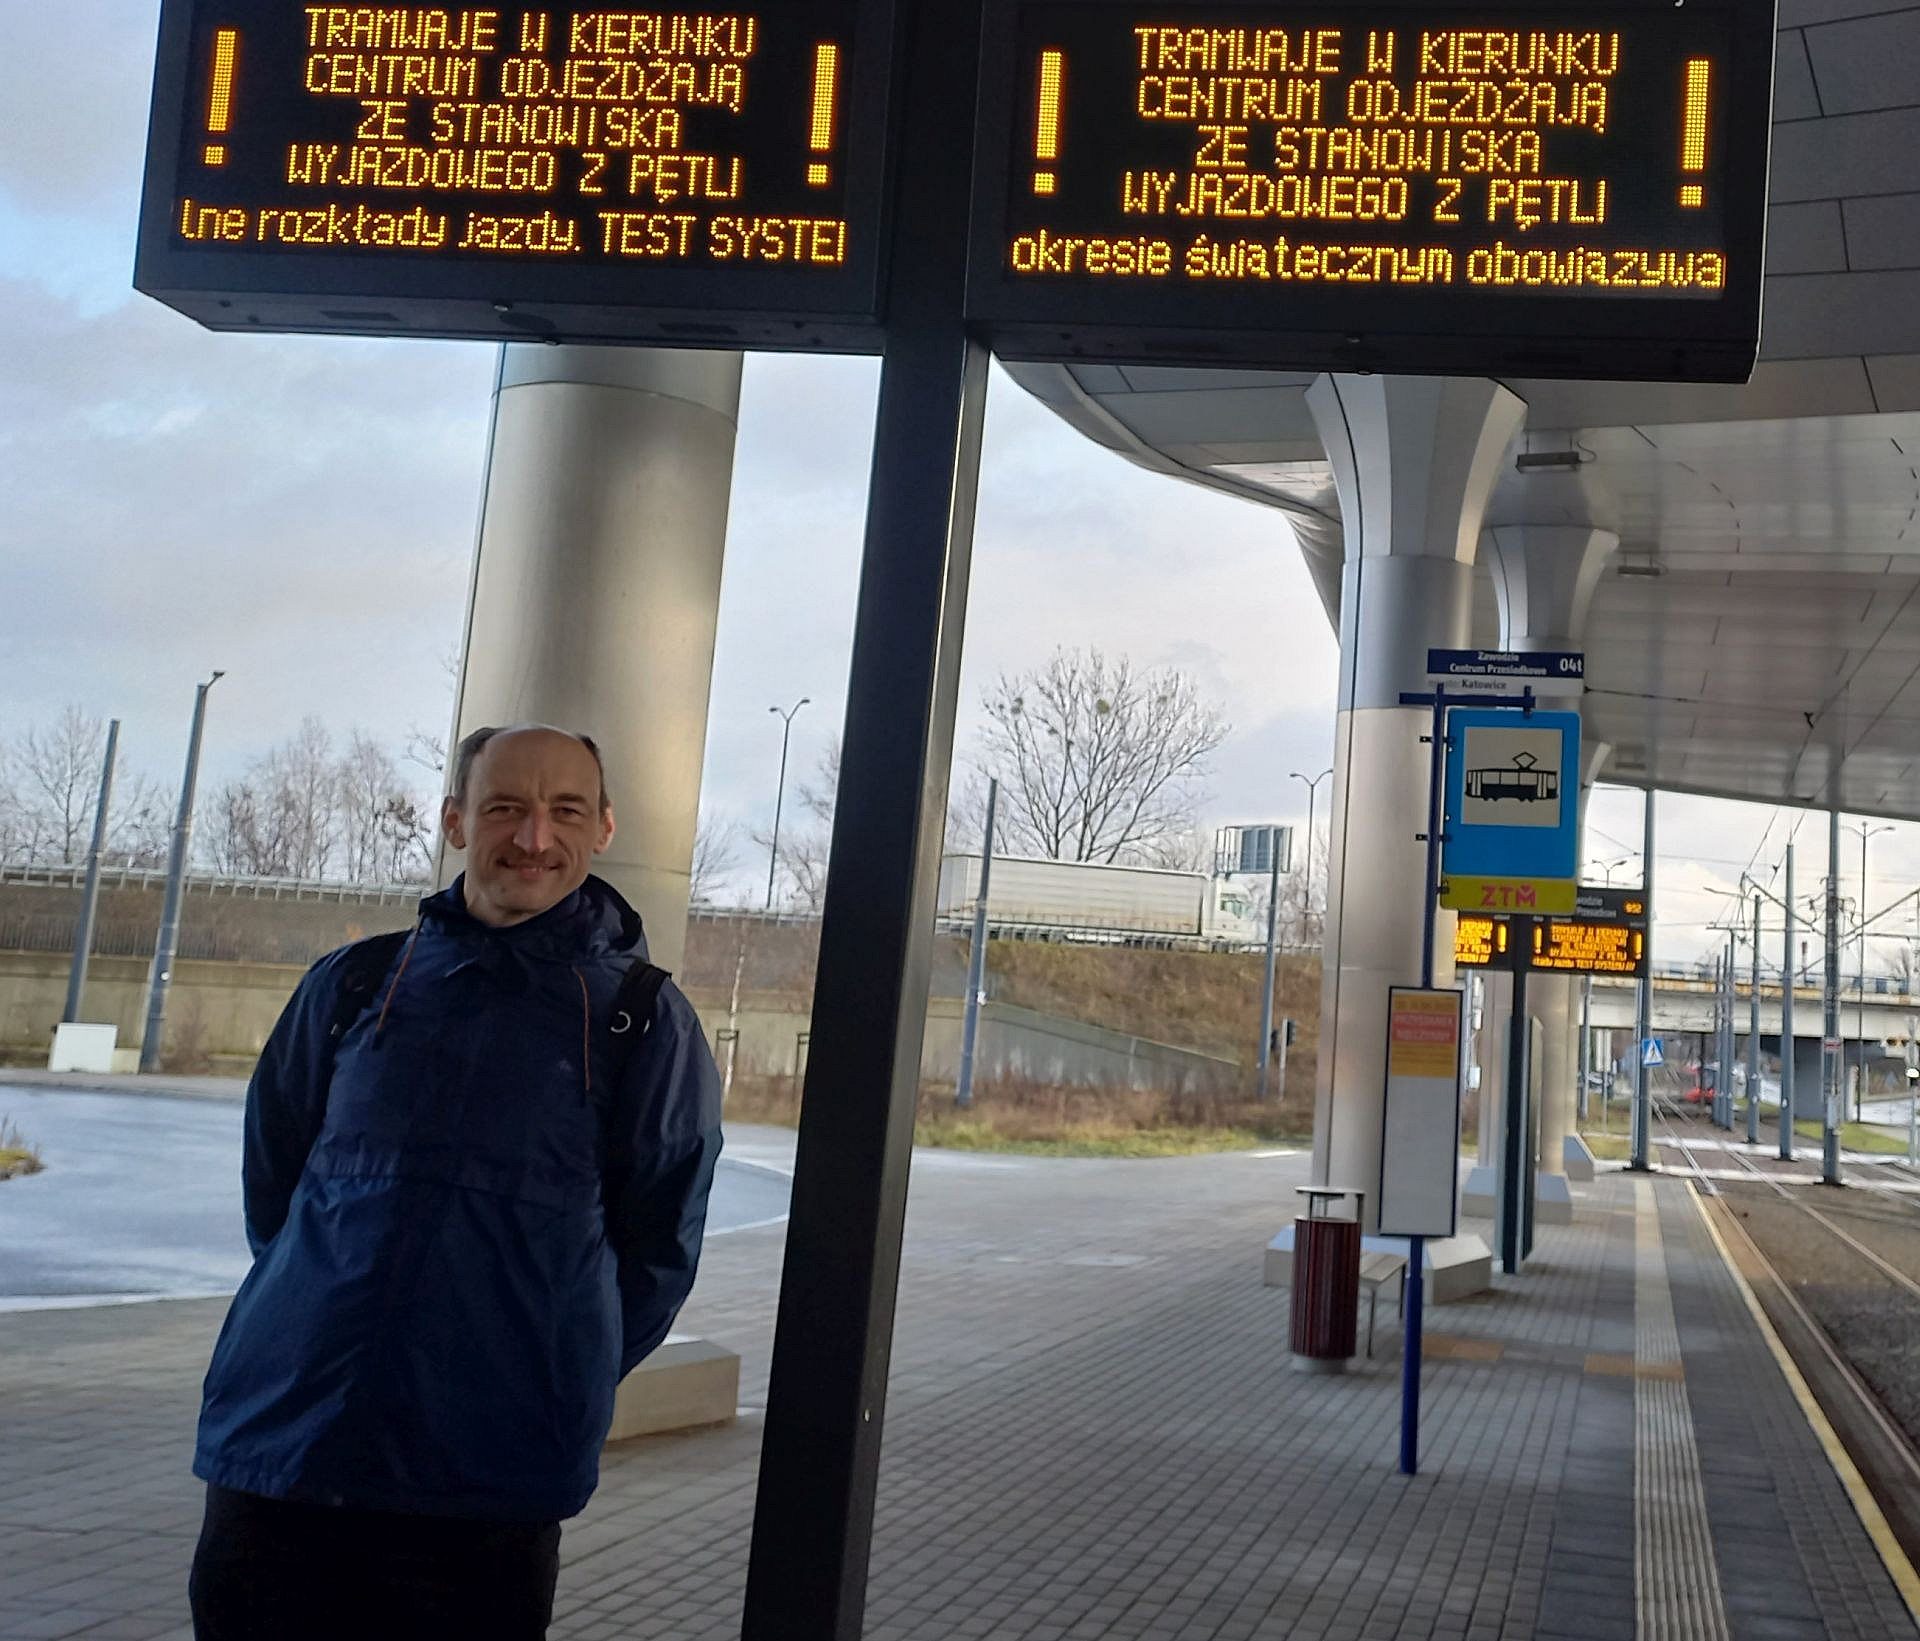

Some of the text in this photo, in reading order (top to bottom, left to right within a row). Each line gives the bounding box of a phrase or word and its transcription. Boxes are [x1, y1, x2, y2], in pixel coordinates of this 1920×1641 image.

[305, 8, 753, 56] TRAMWAJE W KIERUNKU
[1134, 28, 1617, 74] TRAMWAJE W KIERUNKU
[306, 53, 743, 112] CENTRUM ODJEŻDŻAJĄ
[1138, 75, 1606, 134] CENTRUM ODJEŻDŻAJĄ
[357, 100, 679, 147] ZE STANOWISKA
[288, 142, 738, 202] WYJAZDOWEGO Z PĘTLI
[1196, 125, 1539, 172] ZE STANOWISKA
[1123, 171, 1605, 229] WYJAZDOWEGO Z PĘTLI
[257, 203, 445, 246] rozkłady
[458, 210, 579, 251] jazdy.
[598, 212, 696, 255] TEST
[709, 216, 845, 261] SYSTE
[1012, 229, 1721, 286] okresie świątecznym obowiązywa
[1449, 663, 1486, 673] Centrum
[1461, 679, 1507, 690] Katowice
[1480, 884, 1537, 908] ZTM
